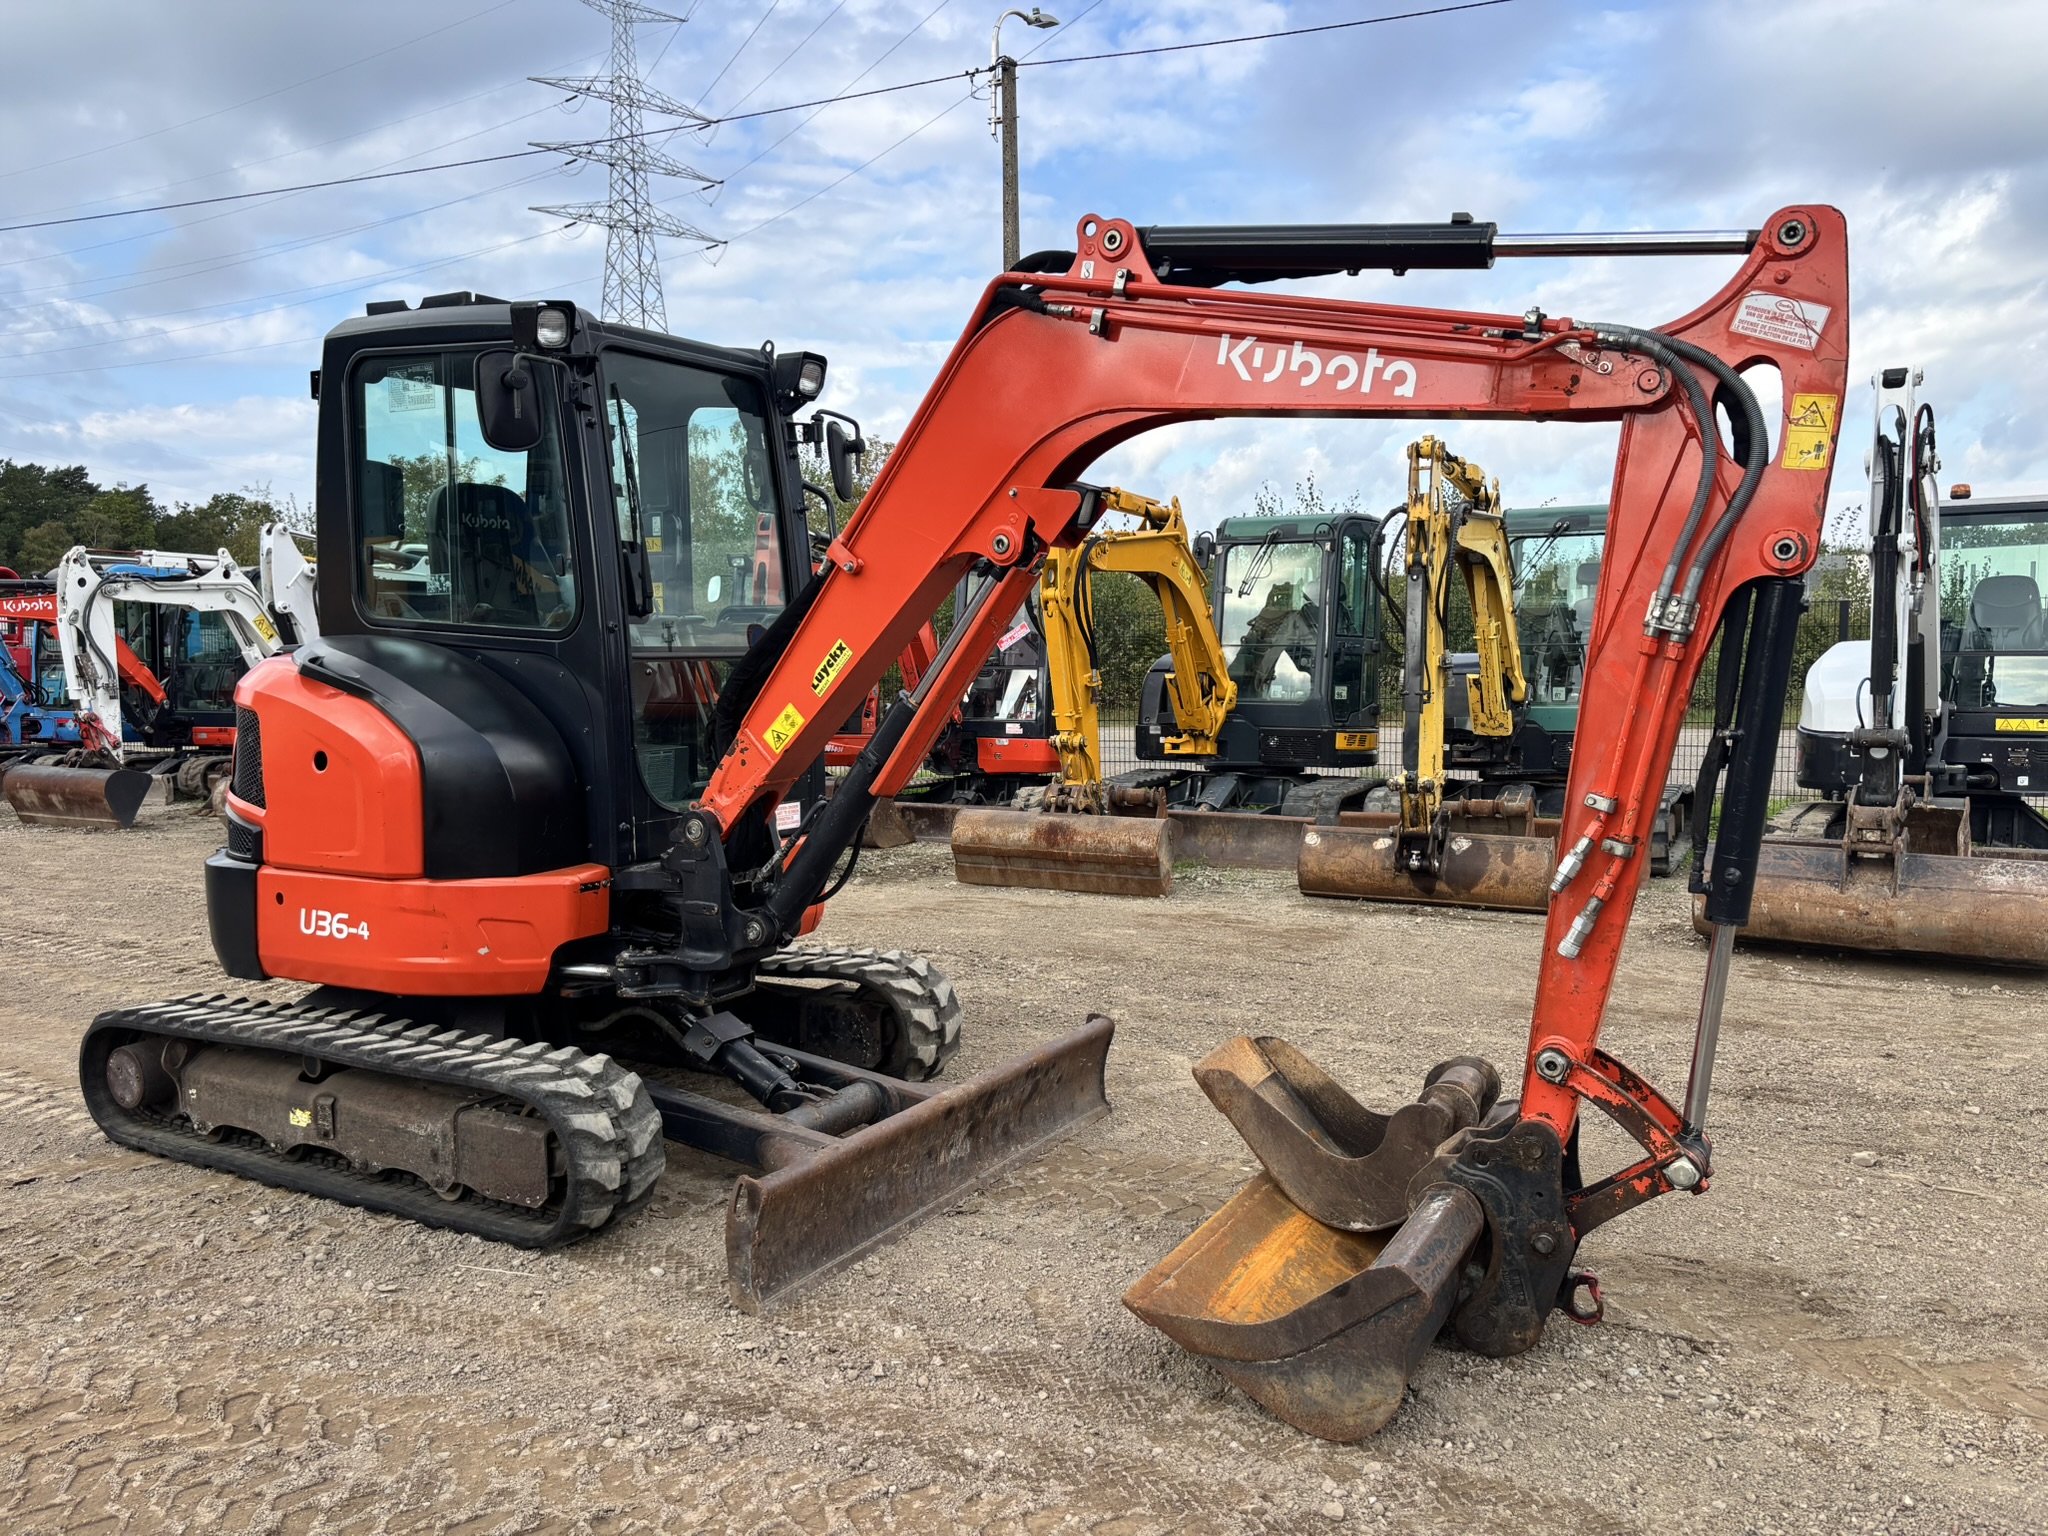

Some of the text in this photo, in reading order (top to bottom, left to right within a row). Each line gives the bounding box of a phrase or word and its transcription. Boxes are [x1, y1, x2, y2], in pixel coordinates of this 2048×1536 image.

[1745, 305, 1770, 314] VERBODEN
[1738, 319, 1760, 328] DEFENSE
[1768, 325, 1798, 337] STATIONNER
[1741, 325, 1757, 333] RAYON
[1758, 329, 1781, 339] D'ACTION
[1217, 334, 1417, 398] Kubota
[462, 513, 511, 529] Kubota
[3, 598, 53, 613] Kubota
[811, 642, 847, 690] Luyckx
[300, 907, 370, 940] U36-4
